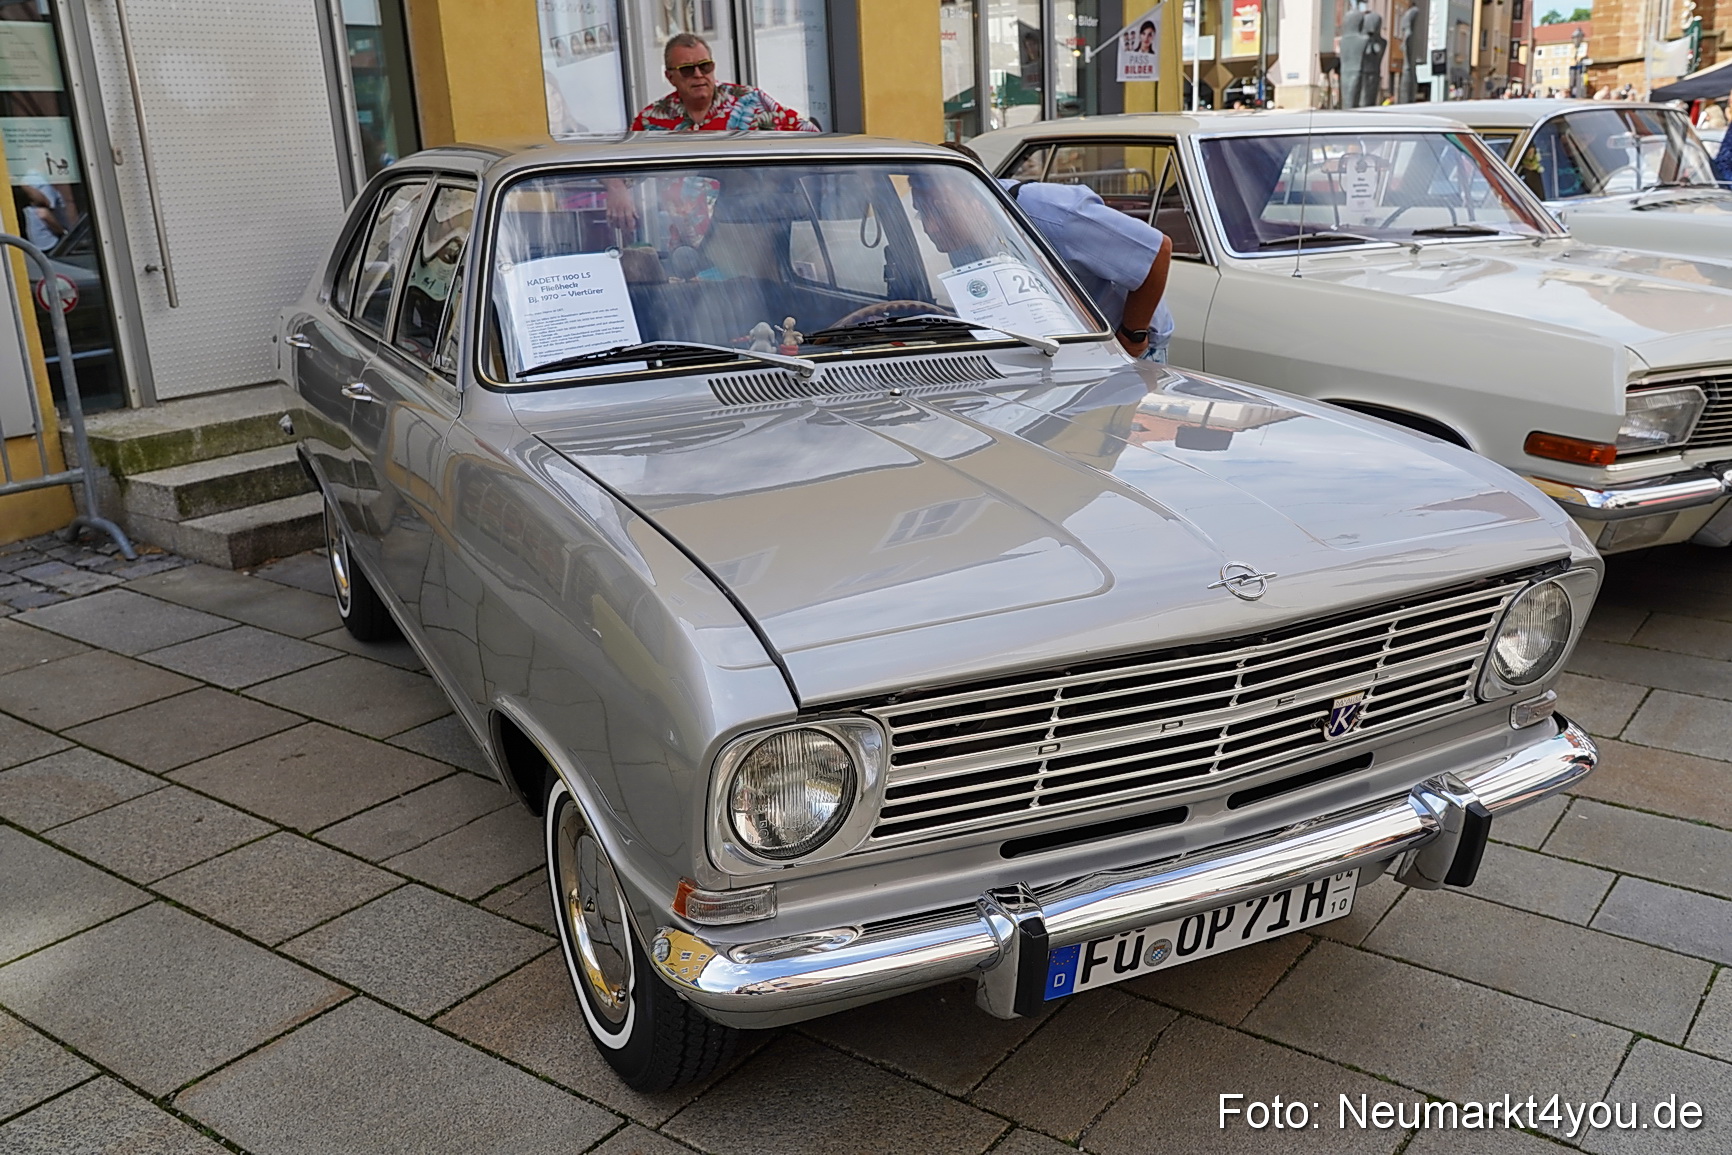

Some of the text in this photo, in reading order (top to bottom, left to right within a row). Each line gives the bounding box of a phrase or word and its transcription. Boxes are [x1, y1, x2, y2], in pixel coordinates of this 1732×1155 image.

[1129, 55, 1149, 64] PASS
[1124, 65, 1153, 75] BILDER
[527, 271, 591, 286] KADETT 1100 LS
[540, 282, 579, 293] Fließheck
[541, 293, 559, 302] 1970
[568, 288, 604, 298] Viertürer
[1330, 897, 1348, 914] 10
[1053, 973, 1065, 988] D
[1080, 928, 1146, 984] FÜ
